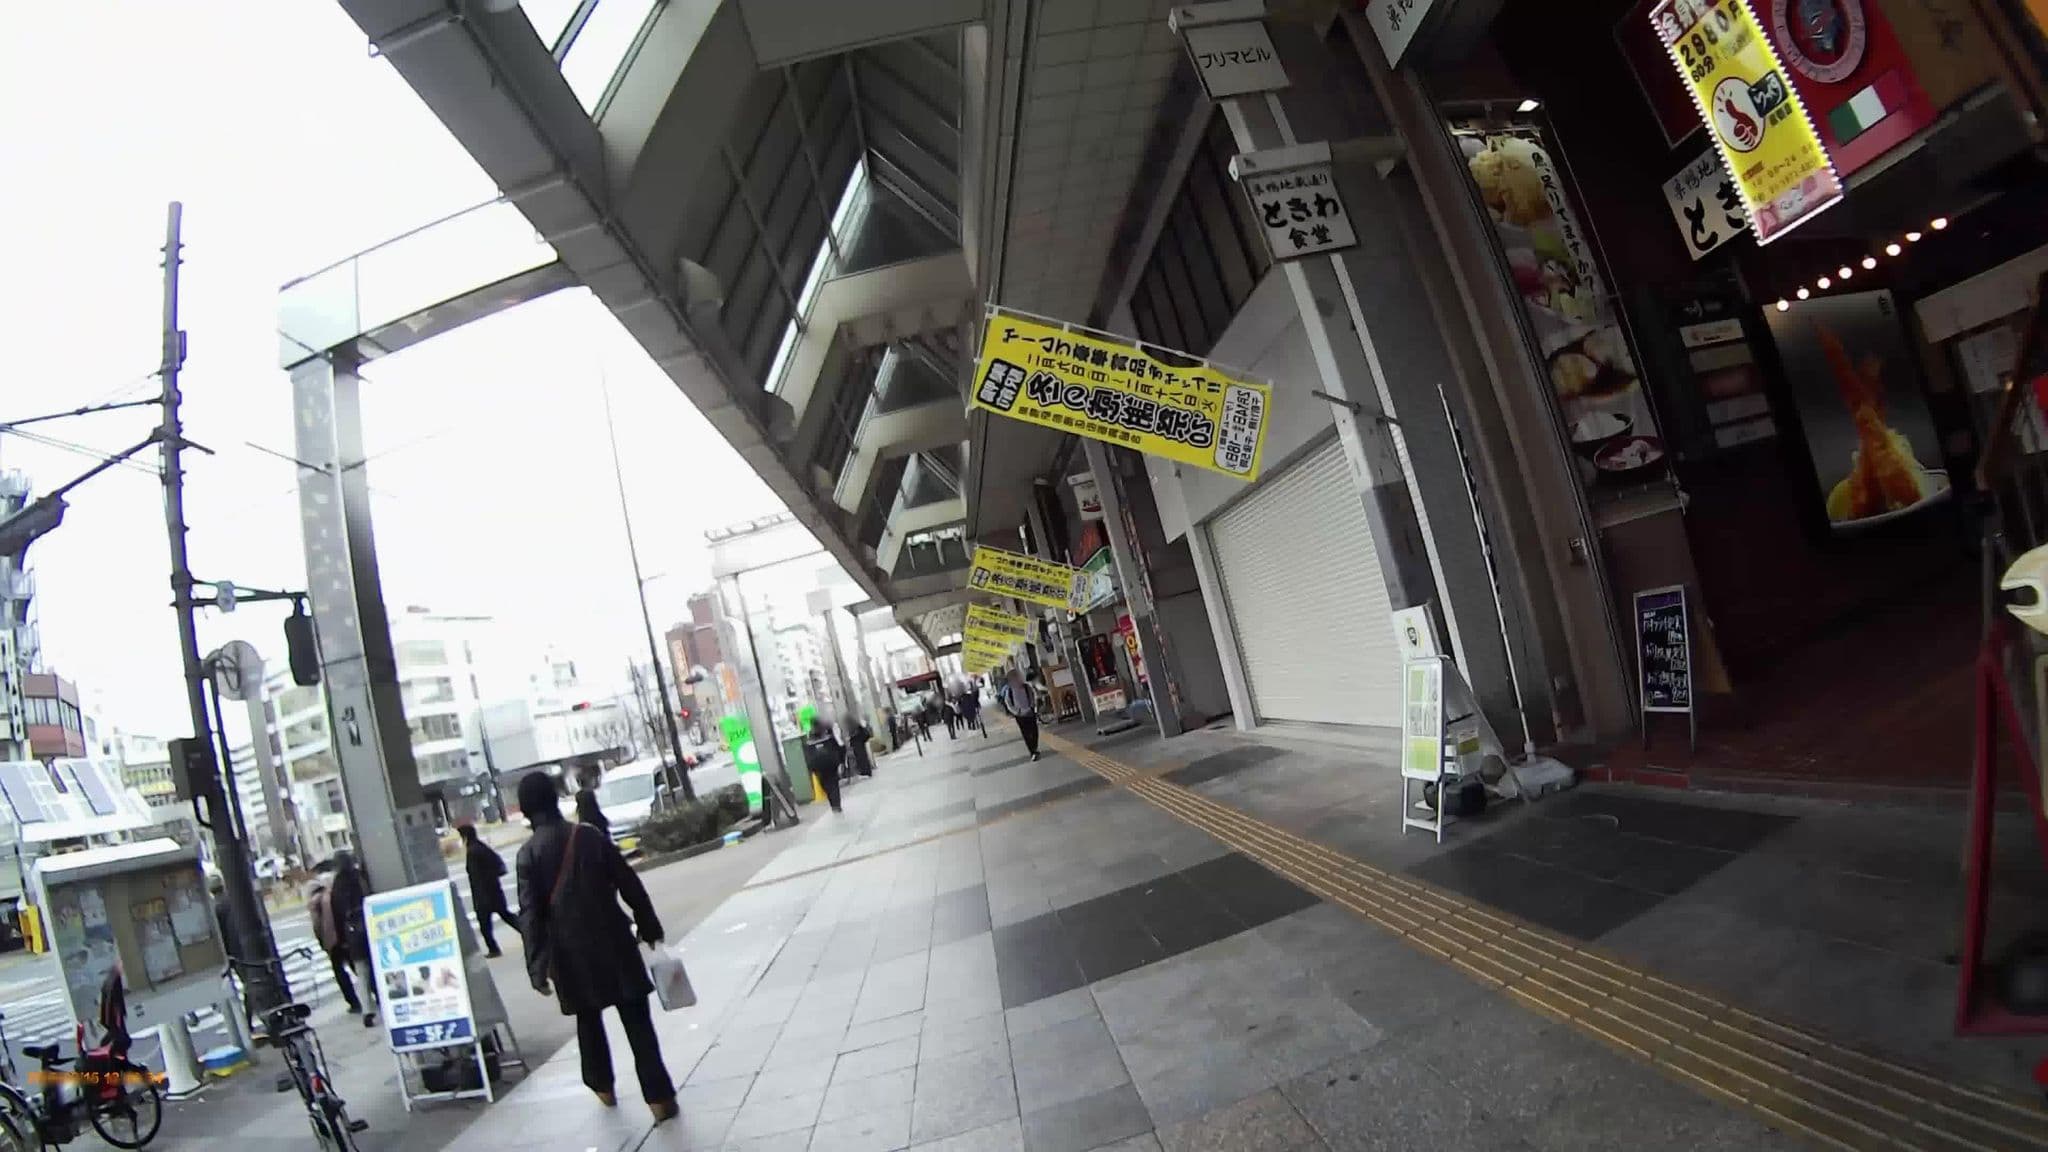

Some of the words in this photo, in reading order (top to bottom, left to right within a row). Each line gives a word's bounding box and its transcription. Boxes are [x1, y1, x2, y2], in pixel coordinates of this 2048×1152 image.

[1262, 192, 1340, 229] ときわ
[1288, 223, 1334, 250] 食堂
